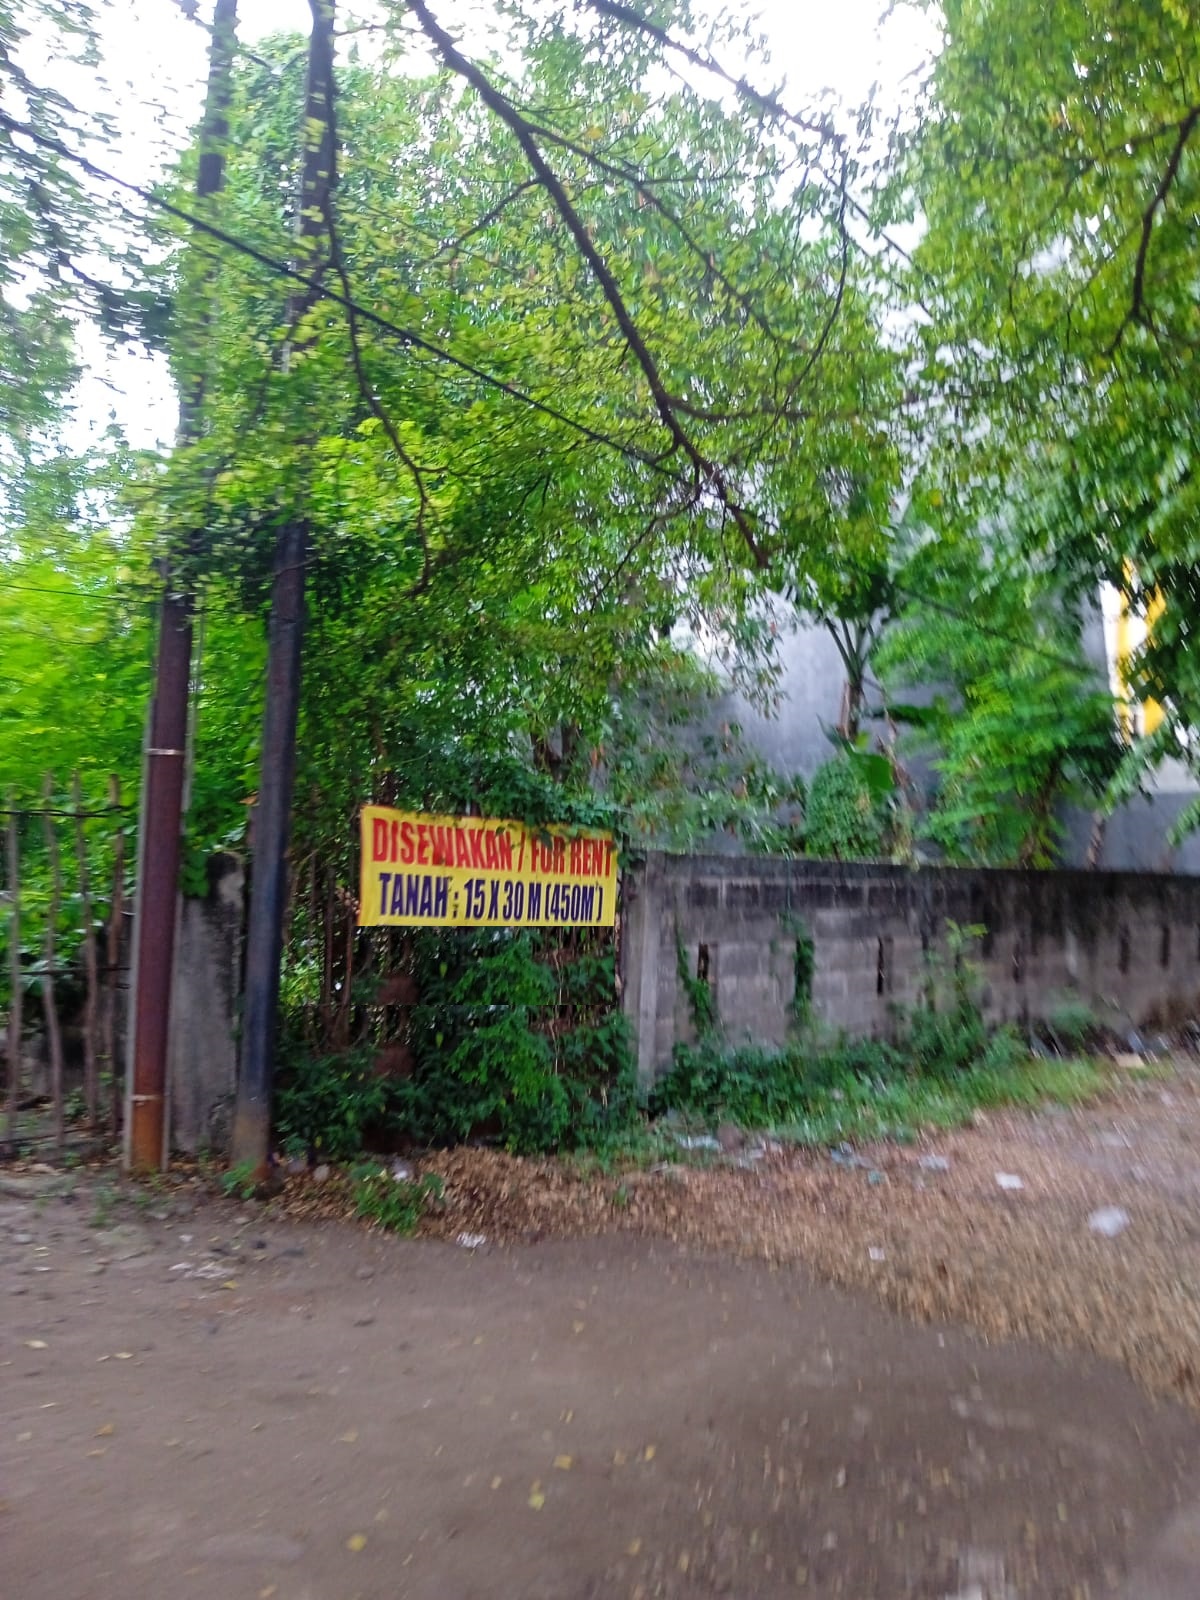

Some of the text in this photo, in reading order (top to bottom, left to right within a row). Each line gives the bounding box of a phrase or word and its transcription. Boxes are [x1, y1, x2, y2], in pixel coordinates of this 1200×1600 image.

[372, 818, 512, 872] DISEWAKAN
[530, 834, 566, 875] FOR
[569, 836, 614, 880] RENT
[378, 872, 449, 919] TANAH
[463, 878, 486, 920] 15
[487, 880, 500, 920] X
[502, 880, 525, 920] 30
[527, 882, 542, 921] M
